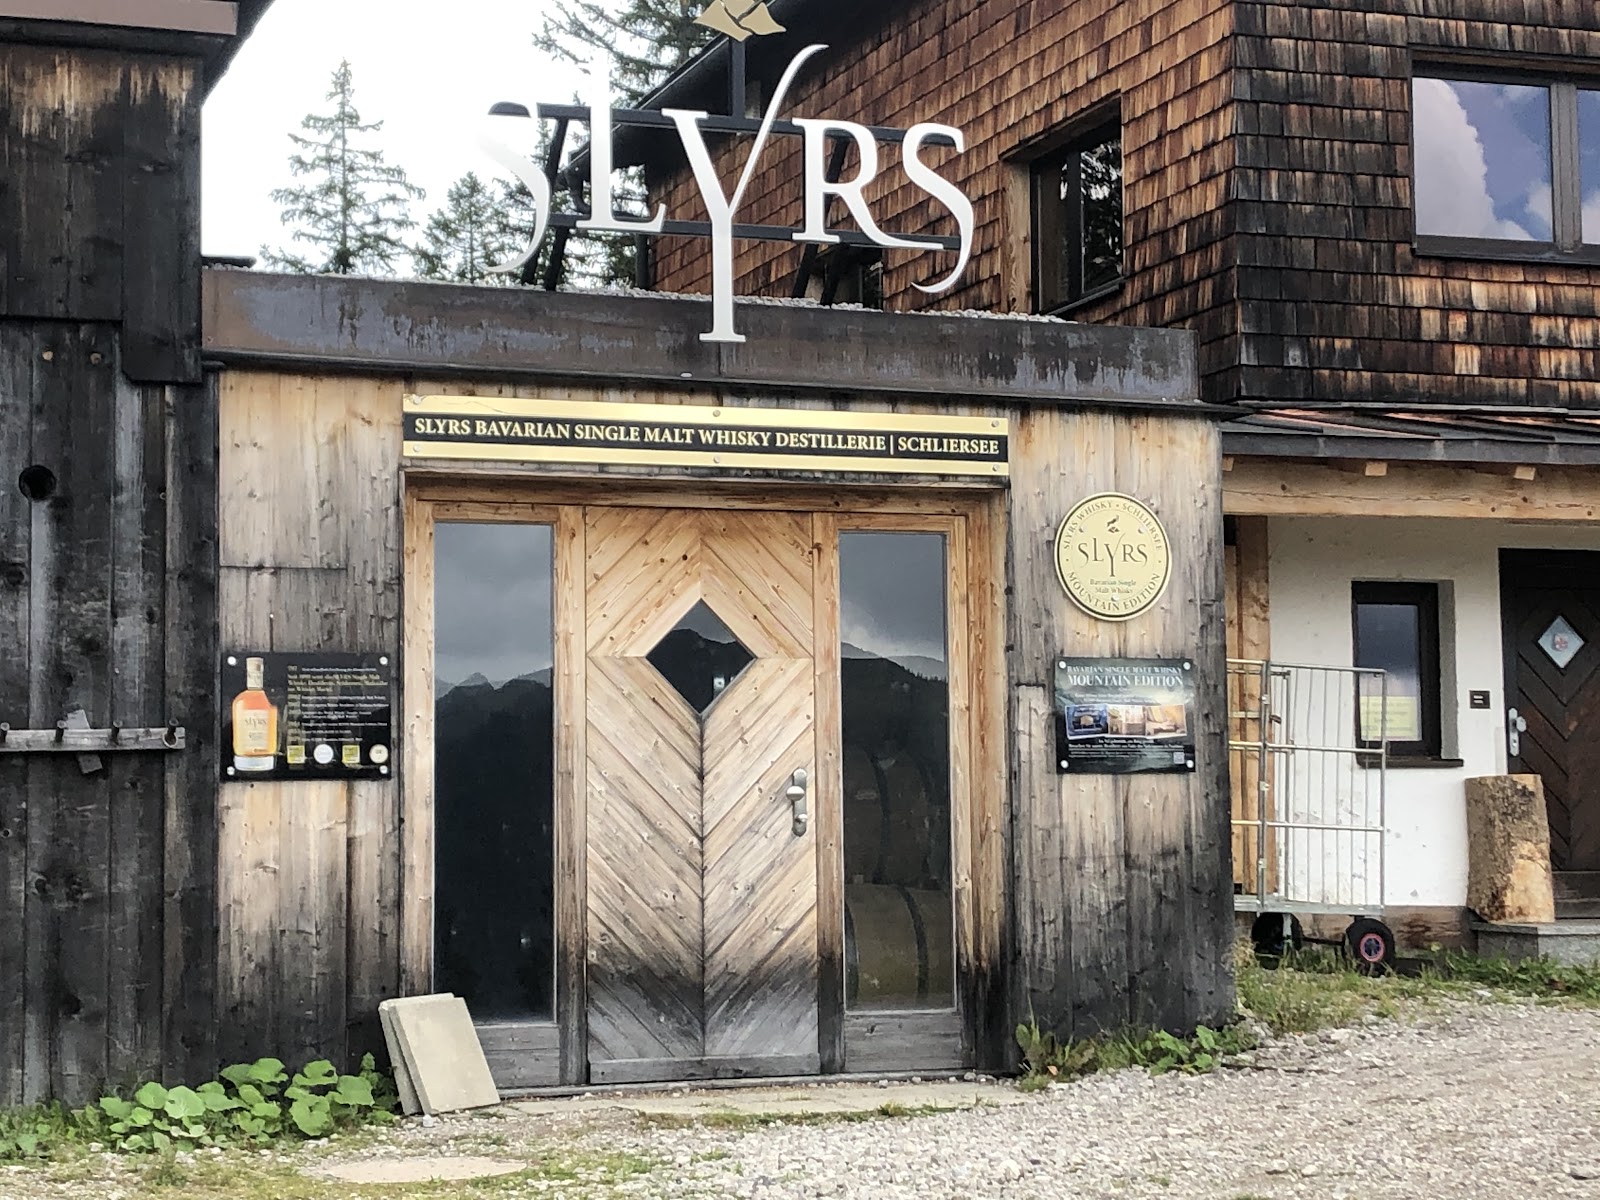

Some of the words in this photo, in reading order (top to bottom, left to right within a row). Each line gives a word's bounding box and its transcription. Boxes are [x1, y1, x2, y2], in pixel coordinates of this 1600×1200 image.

[476, 44, 974, 343] SLYRS
[415, 417, 471, 435] SLYRS
[475, 420, 570, 439] BAVARIAN
[574, 423, 641, 442] SINGLE
[643, 426, 695, 443] MALT
[698, 428, 772, 447] WHISKY
[775, 431, 886, 451] DESTILLERIE
[897, 436, 1000, 455] SCHLIERSEE
[1063, 521, 1079, 550] SLYRS
[1076, 500, 1113, 521] WHISKY
[1122, 502, 1162, 550] SCHLIERSEE
[1077, 532, 1148, 577] SLYRS
[1068, 571, 1120, 611] MOUNTAIN
[1123, 572, 1161, 610] EDITION
[1068, 674, 1131, 686] MOUNTAIN
[1134, 674, 1184, 687] EDITION
